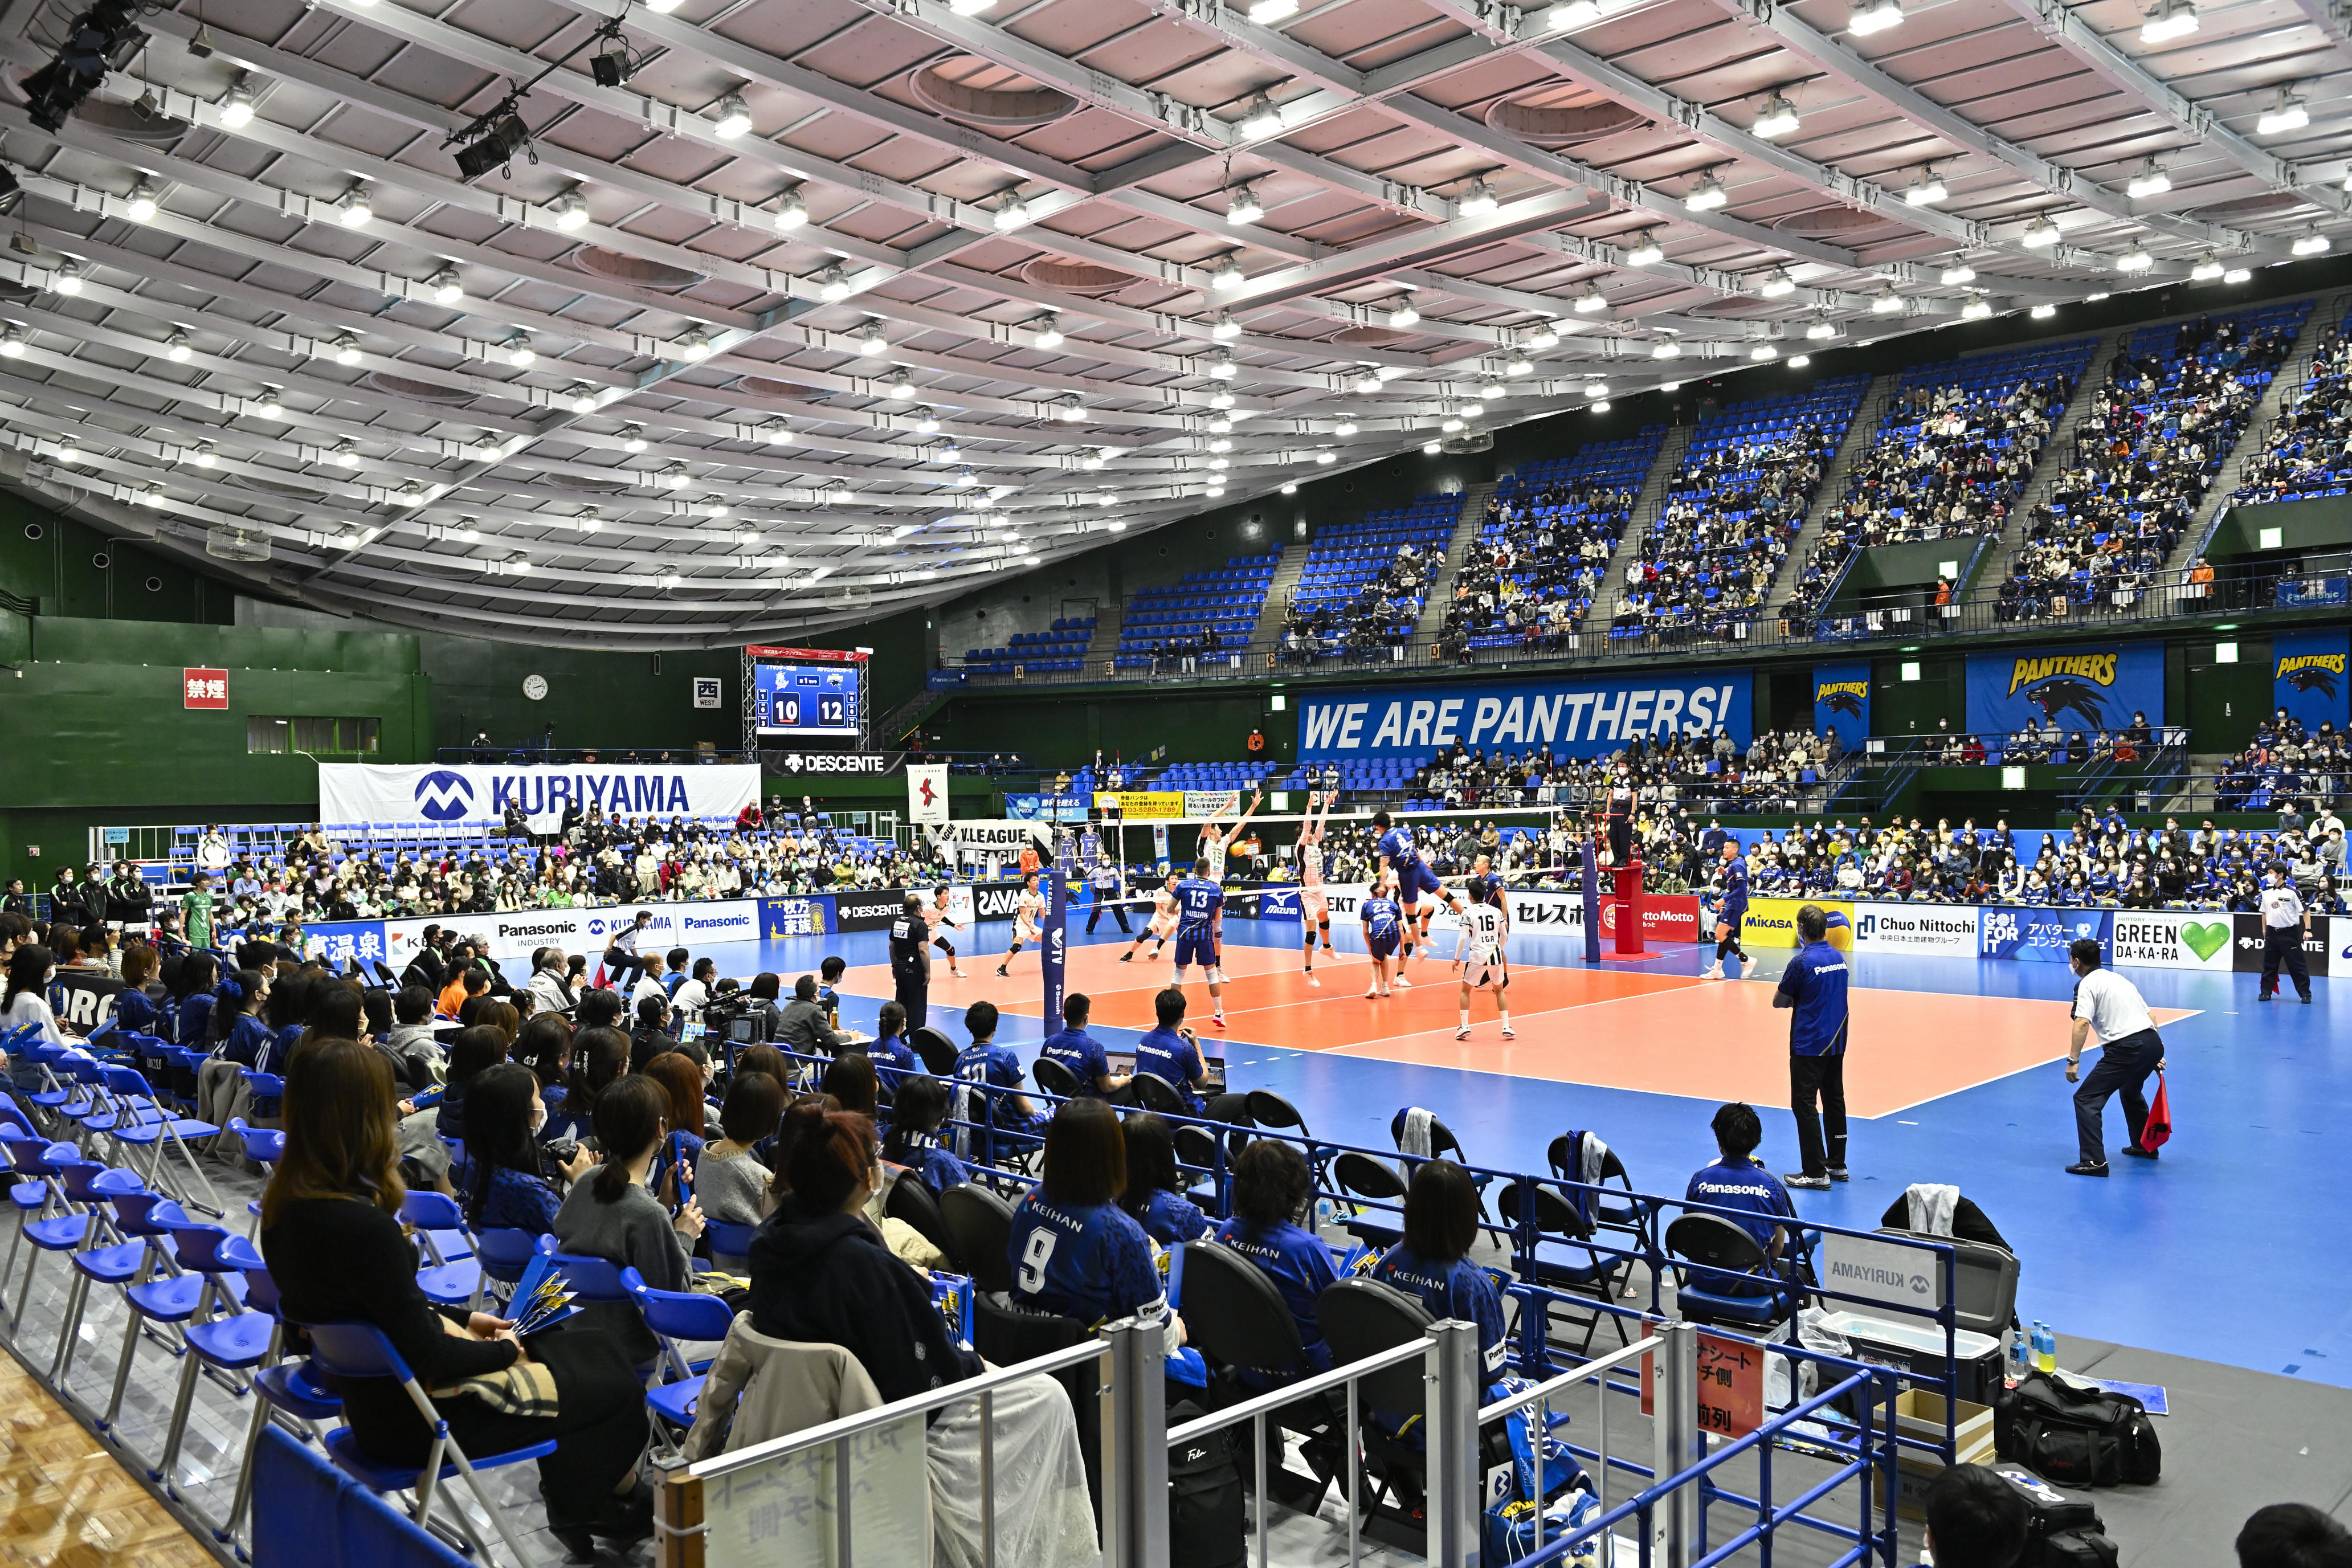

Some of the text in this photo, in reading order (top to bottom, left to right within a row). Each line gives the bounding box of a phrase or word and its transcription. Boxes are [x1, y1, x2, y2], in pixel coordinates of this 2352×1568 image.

[1016, 668, 1023, 676] A
[1106, 663, 1113, 672] B
[2276, 654, 2346, 679] PANTHERS
[2007, 654, 2118, 700] PANTHERS
[187, 679, 226, 699] 禁煙
[697, 681, 718, 699] 西
[1816, 680, 1868, 701] PANTHERS
[775, 701, 798, 720] 10
[822, 701, 842, 720] 12
[1305, 685, 1733, 749] WE ARE PANTHERS!
[806, 756, 884, 771] DESCENTE
[493, 775, 689, 815] KURIYAMA
[1042, 798, 1080, 807] 勝利を超える
[961, 828, 1026, 844] V.LEAGUE
[783, 899, 810, 914] 枚方
[978, 888, 1020, 916] SAVA
[1190, 890, 1208, 908] 13
[1328, 897, 1357, 913] EKT
[853, 904, 904, 918] DESCENTE
[1373, 903, 1390, 914] 22
[499, 920, 577, 937] Panasonic
[684, 914, 750, 929] Panasonic
[785, 919, 812, 935] 家族
[1478, 915, 1495, 932] 16
[1745, 916, 1793, 929] MIKASA
[1881, 918, 1975, 934] Chuo Nittochi
[2028, 924, 2074, 935] アバター
[1880, 934, 1960, 945] 中央日本土地建物グループ
[1983, 926, 2019, 941] FOR
[2116, 924, 2177, 944] GREEN
[517, 937, 560, 947] INDUSTRY
[1983, 940, 2000, 953] IT
[965, 1052, 988, 1060] KEIHAN
[1047, 1046, 1083, 1060] Panasonic
[1137, 1043, 1172, 1059] Panasonic
[1698, 1181, 1771, 1199] Panasonic
[1032, 1201, 1083, 1232] KEIHAN
[1231, 1239, 1280, 1259] KEIHAN
[1019, 1226, 1057, 1295] 9
[1394, 1270, 1444, 1291] KEIHAN
